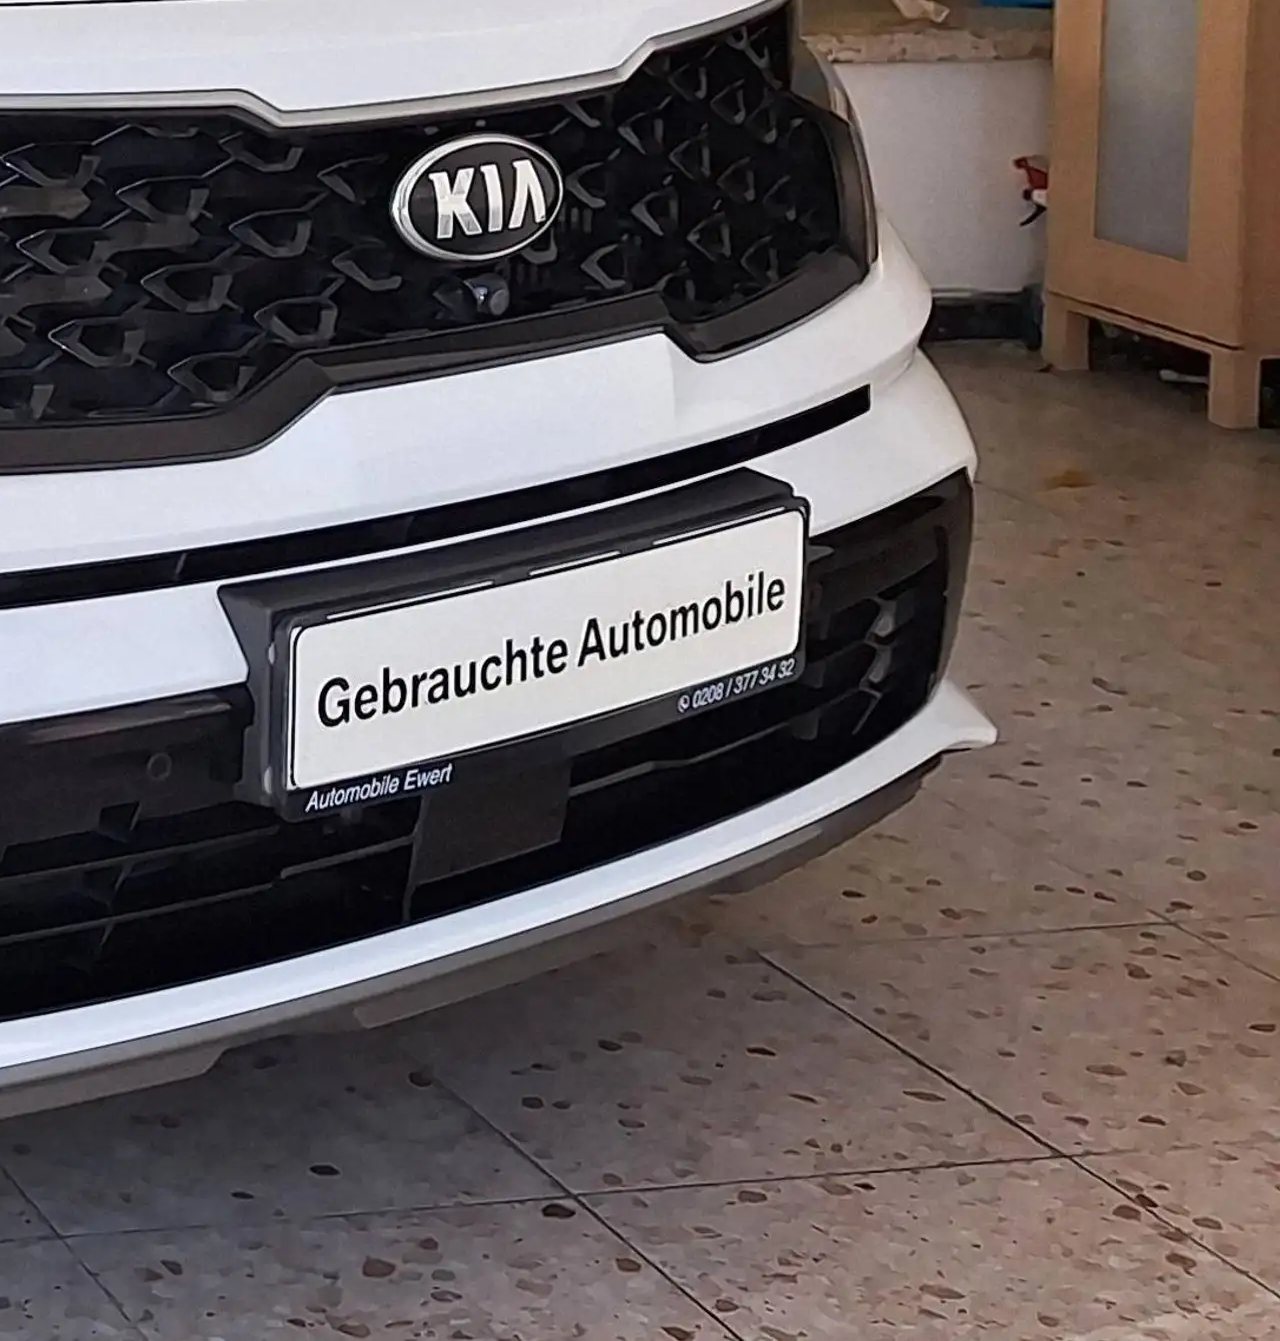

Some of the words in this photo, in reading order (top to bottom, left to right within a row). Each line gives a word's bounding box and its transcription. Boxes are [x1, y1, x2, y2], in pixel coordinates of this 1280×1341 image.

[428, 159, 547, 239] KIA
[317, 635, 568, 727] Gebrauchte
[578, 571, 785, 667] Automobile
[692, 682, 724, 708] 0208
[733, 670, 759, 694] 377
[759, 664, 777, 685] 34
[778, 658, 795, 678] 32
[305, 773, 400, 813] Automobile
[403, 763, 453, 791] Ewert
